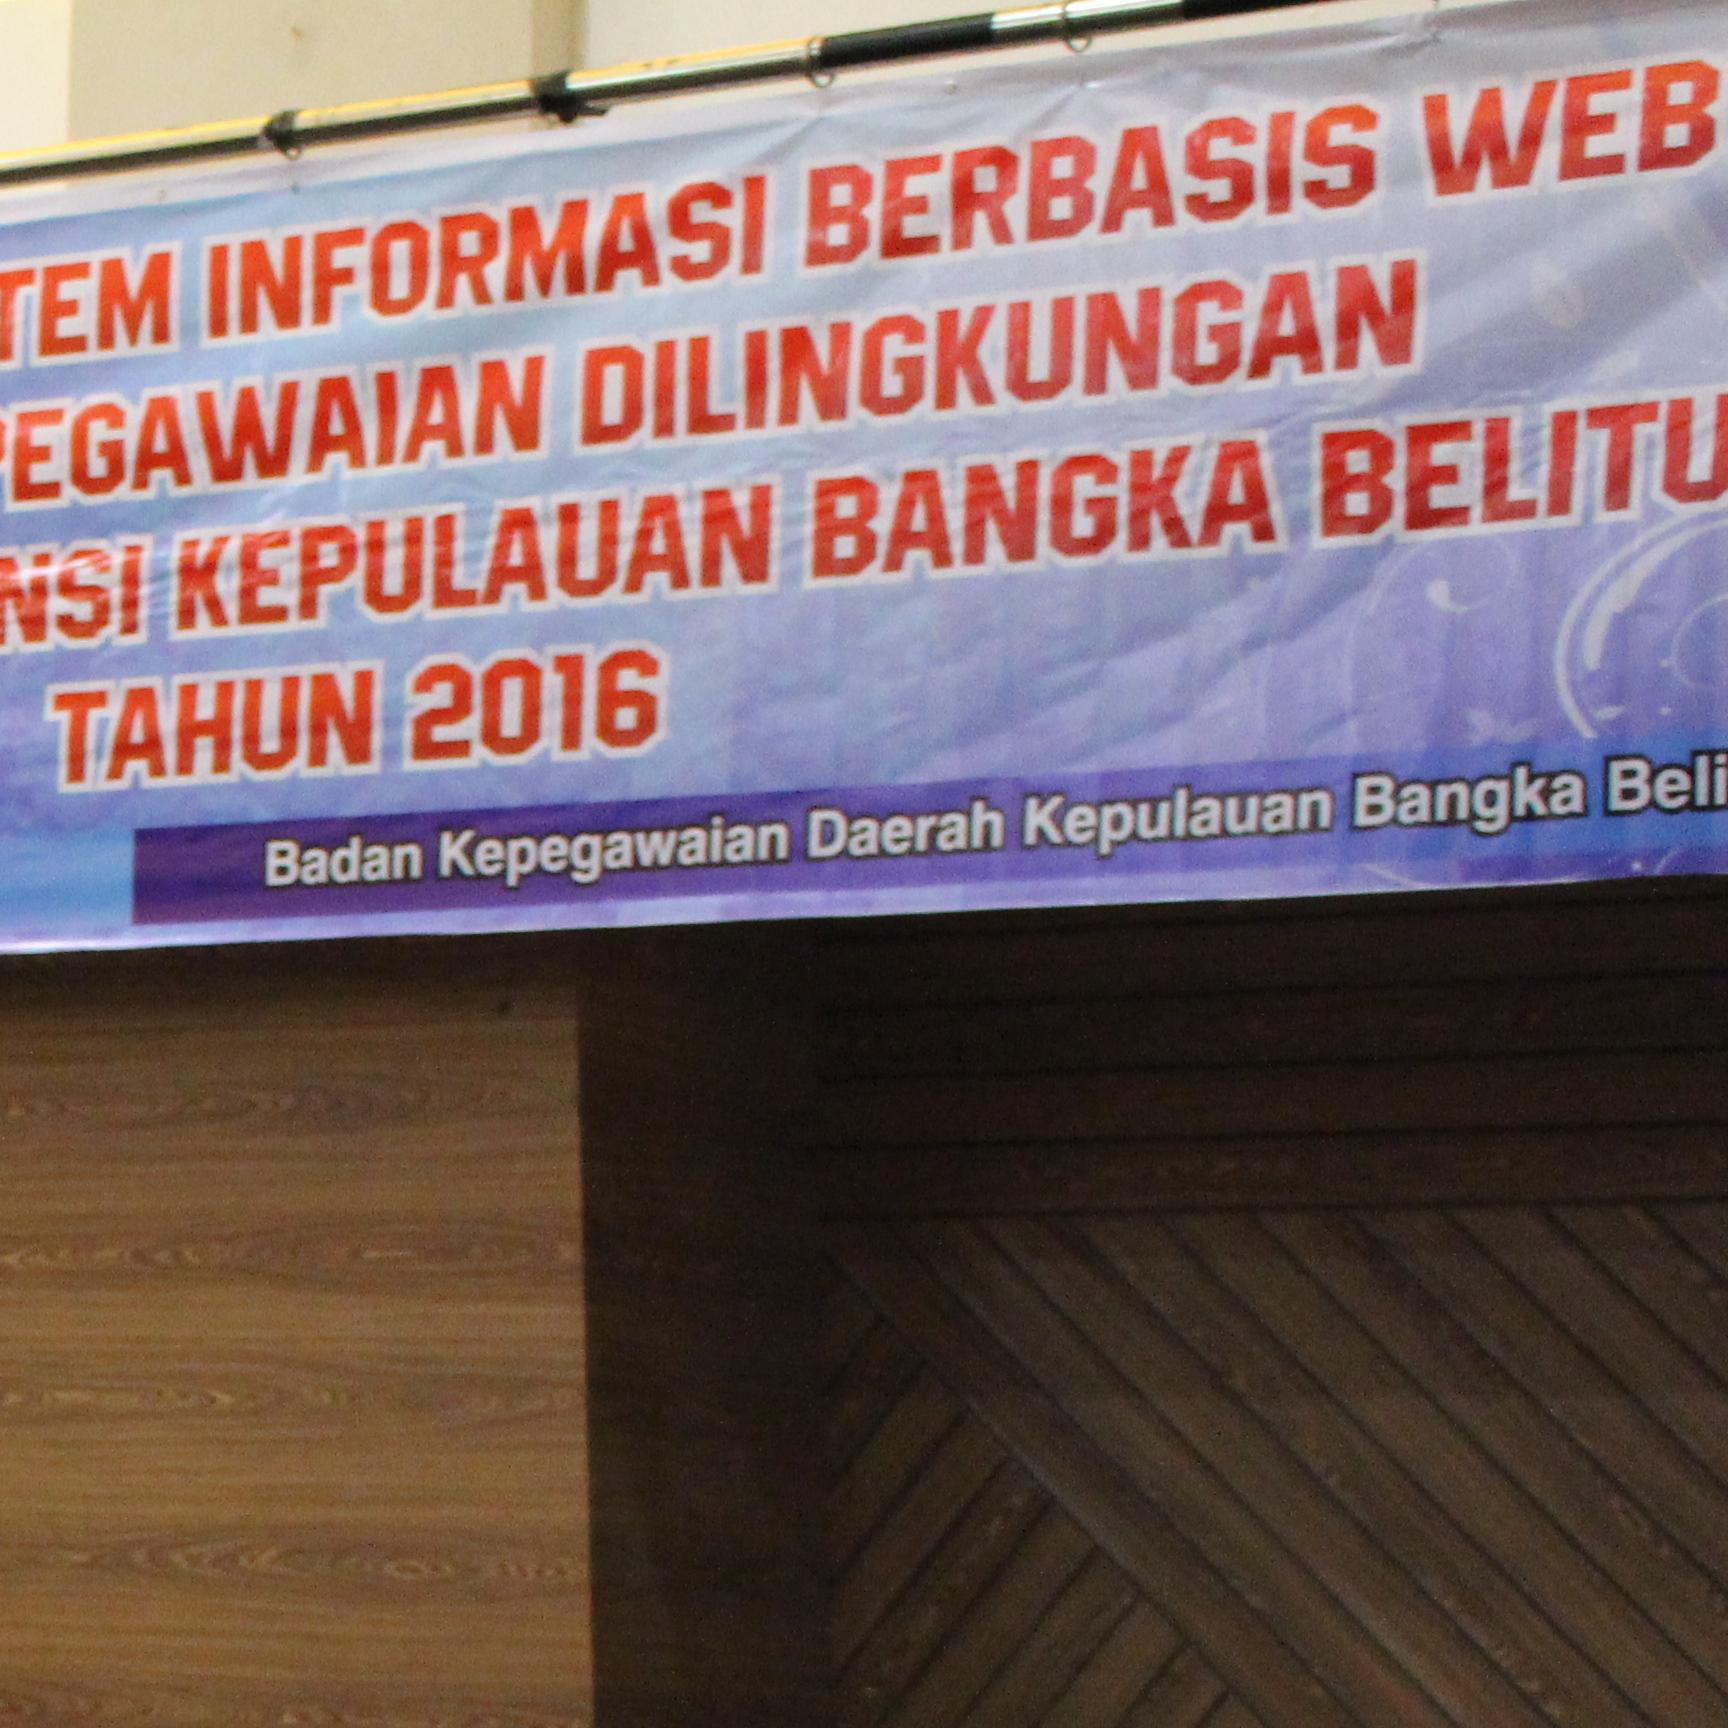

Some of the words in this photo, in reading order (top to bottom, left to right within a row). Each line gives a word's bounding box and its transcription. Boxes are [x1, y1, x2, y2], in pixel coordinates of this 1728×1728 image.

[208, 176, 766, 340] INFORMASI
[805, 104, 1378, 268] BERBASIS
[1422, 60, 1722, 197] WEB
[580, 258, 1417, 446] DILINGKUNGAN
[175, 482, 774, 632] KEPULAUAN
[811, 439, 1278, 581] BANGKA
[1320, 392, 1728, 540] BELITU
[52, 669, 375, 786] TAHUN
[409, 647, 661, 761] 2016
[264, 834, 424, 888] Badan
[438, 814, 790, 890] Kepegawaian
[806, 798, 1005, 864] Daerah
[1020, 780, 1333, 862] Kepulauan
[1352, 762, 1586, 838] Bangka
[1606, 752, 1728, 812] Beli
